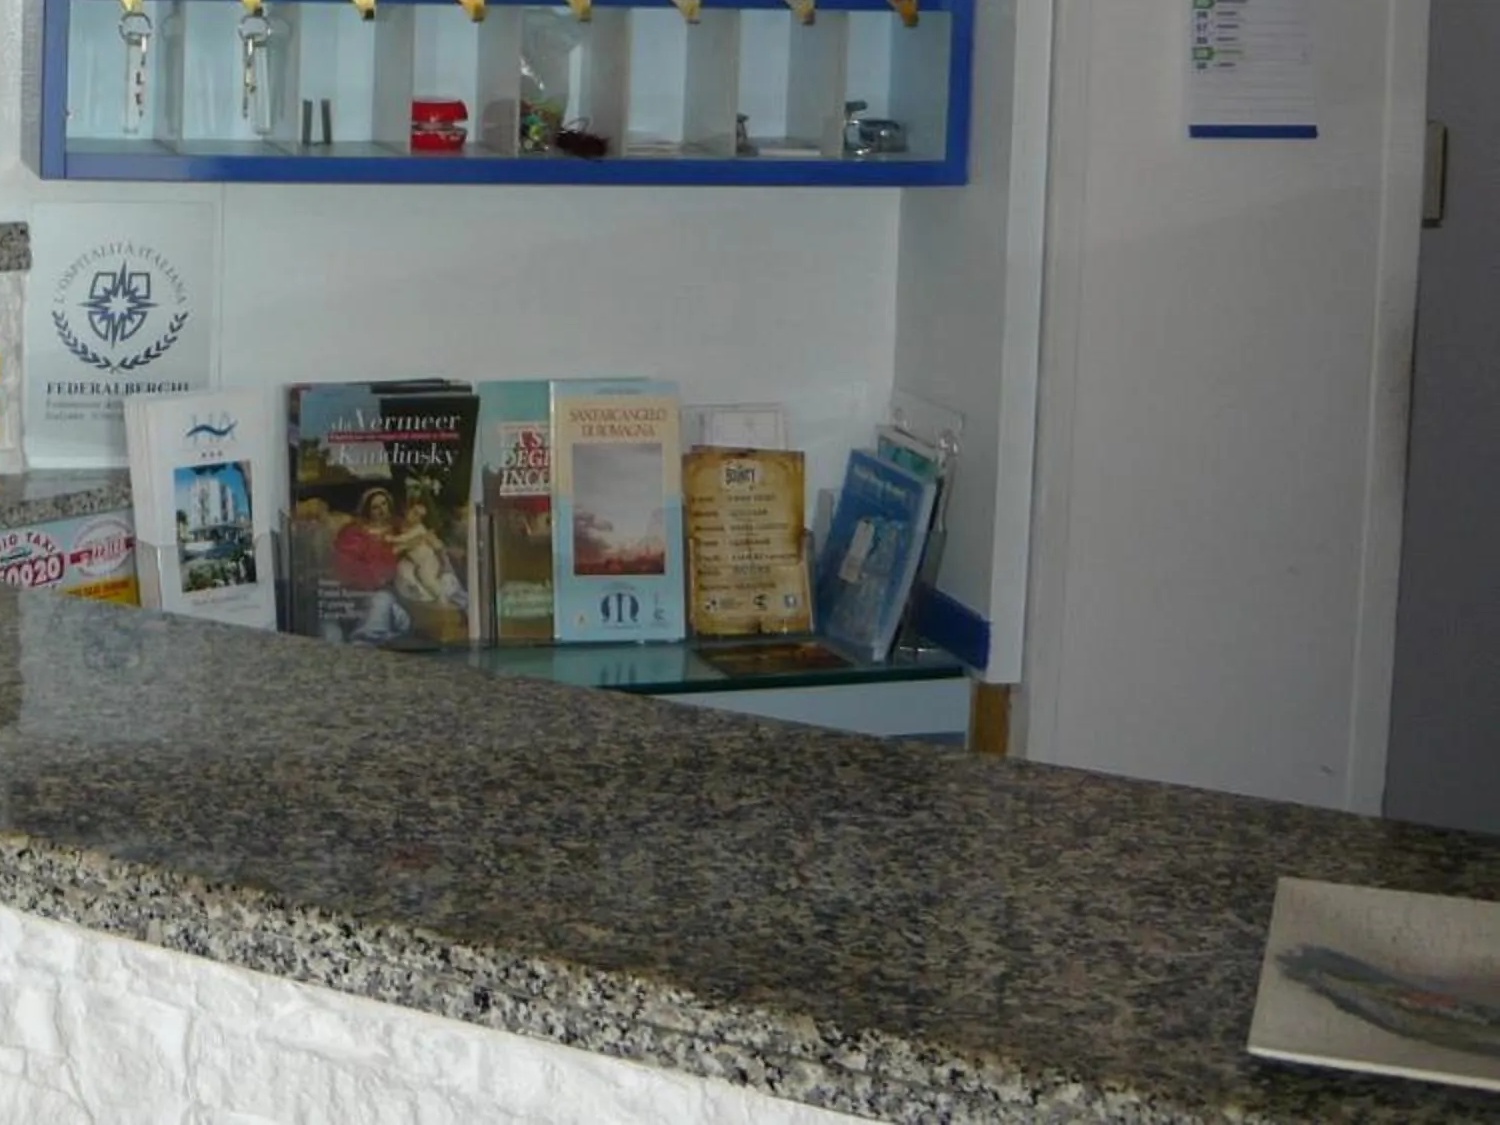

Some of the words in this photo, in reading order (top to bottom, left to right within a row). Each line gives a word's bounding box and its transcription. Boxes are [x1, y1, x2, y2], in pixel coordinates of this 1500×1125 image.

[355, 408, 462, 431] Vermeer
[338, 441, 457, 473] Kandinsky
[26, 531, 56, 553] TAXI
